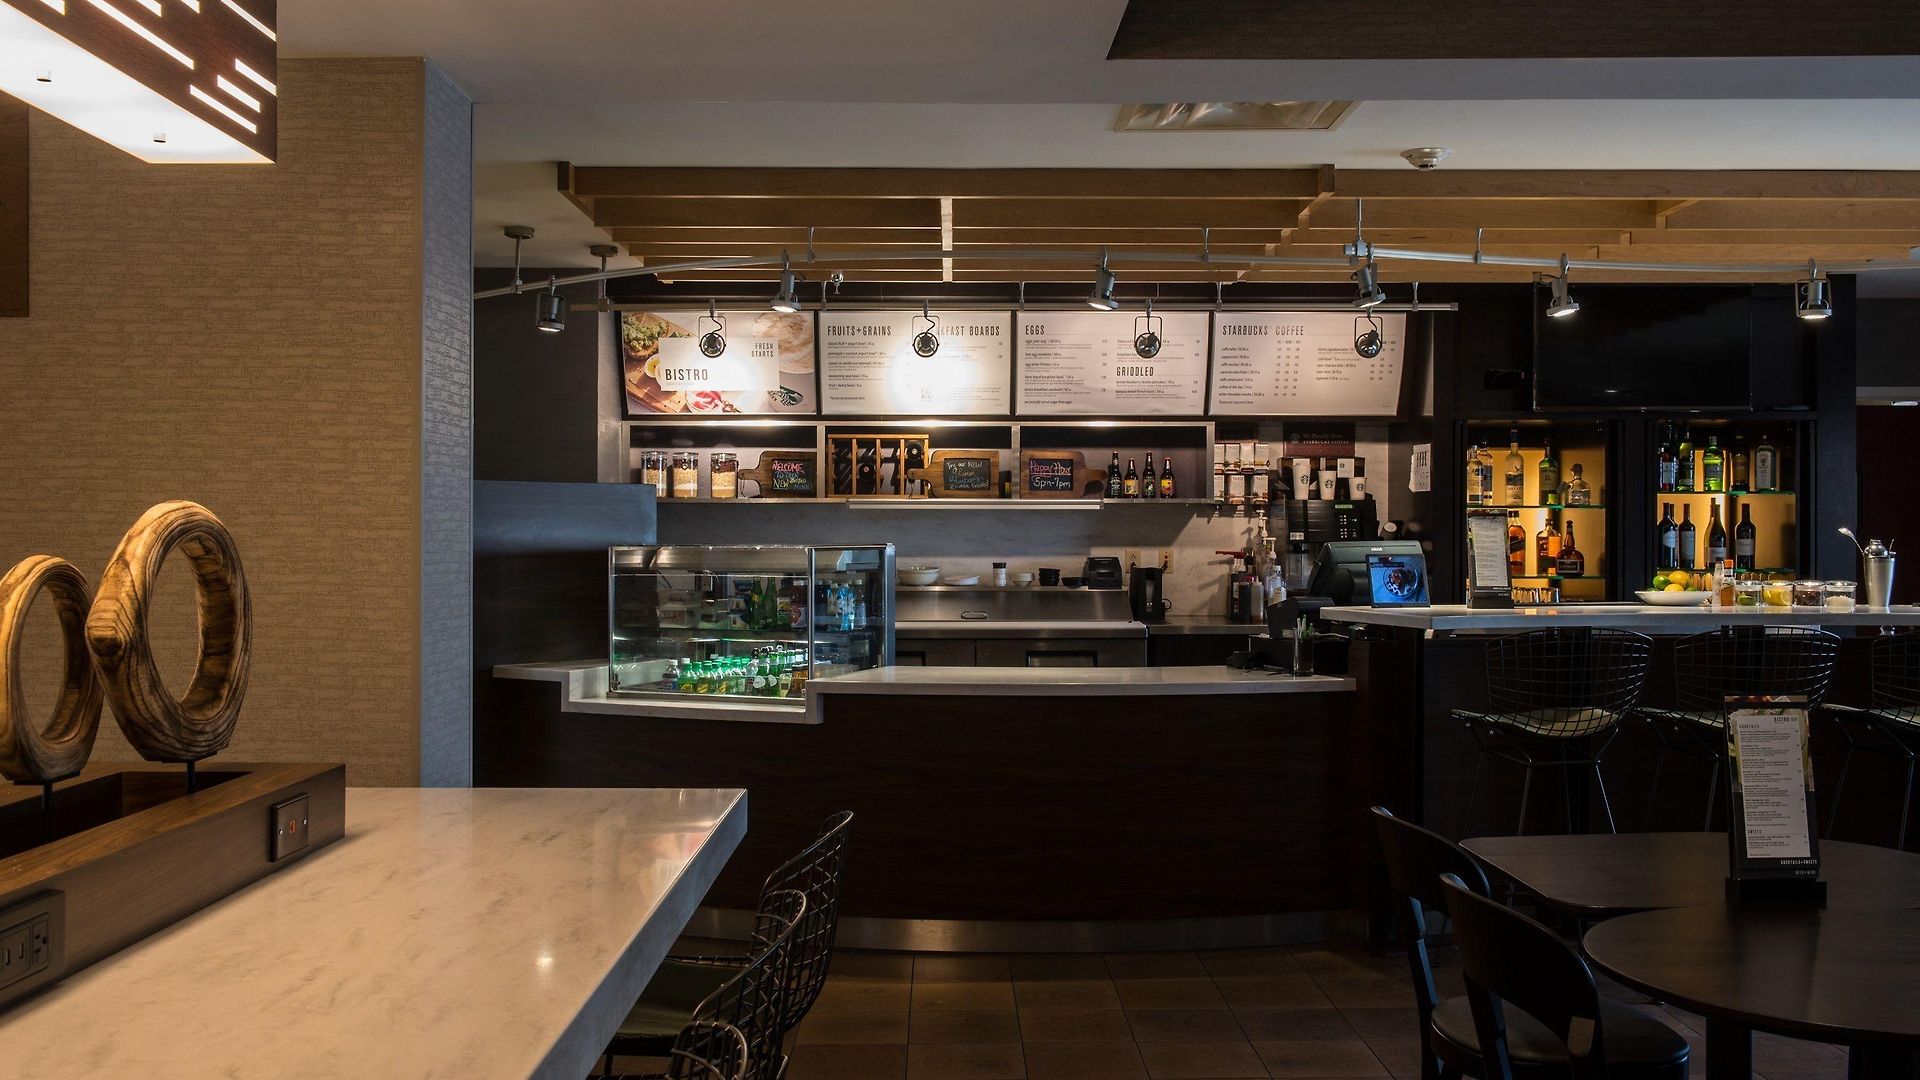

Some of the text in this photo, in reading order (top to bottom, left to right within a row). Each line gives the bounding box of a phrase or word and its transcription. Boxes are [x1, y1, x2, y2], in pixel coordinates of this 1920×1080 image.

[827, 325, 892, 336] FRUITS+GRAINS
[969, 325, 1000, 336] BOARDS
[1025, 324, 1045, 335] EGGS
[1222, 325, 1304, 336] STARBUCKS COFFEE
[751, 350, 774, 358] STARTS
[665, 368, 709, 381] BISTRO
[1116, 366, 1154, 377] GRIDDLED
